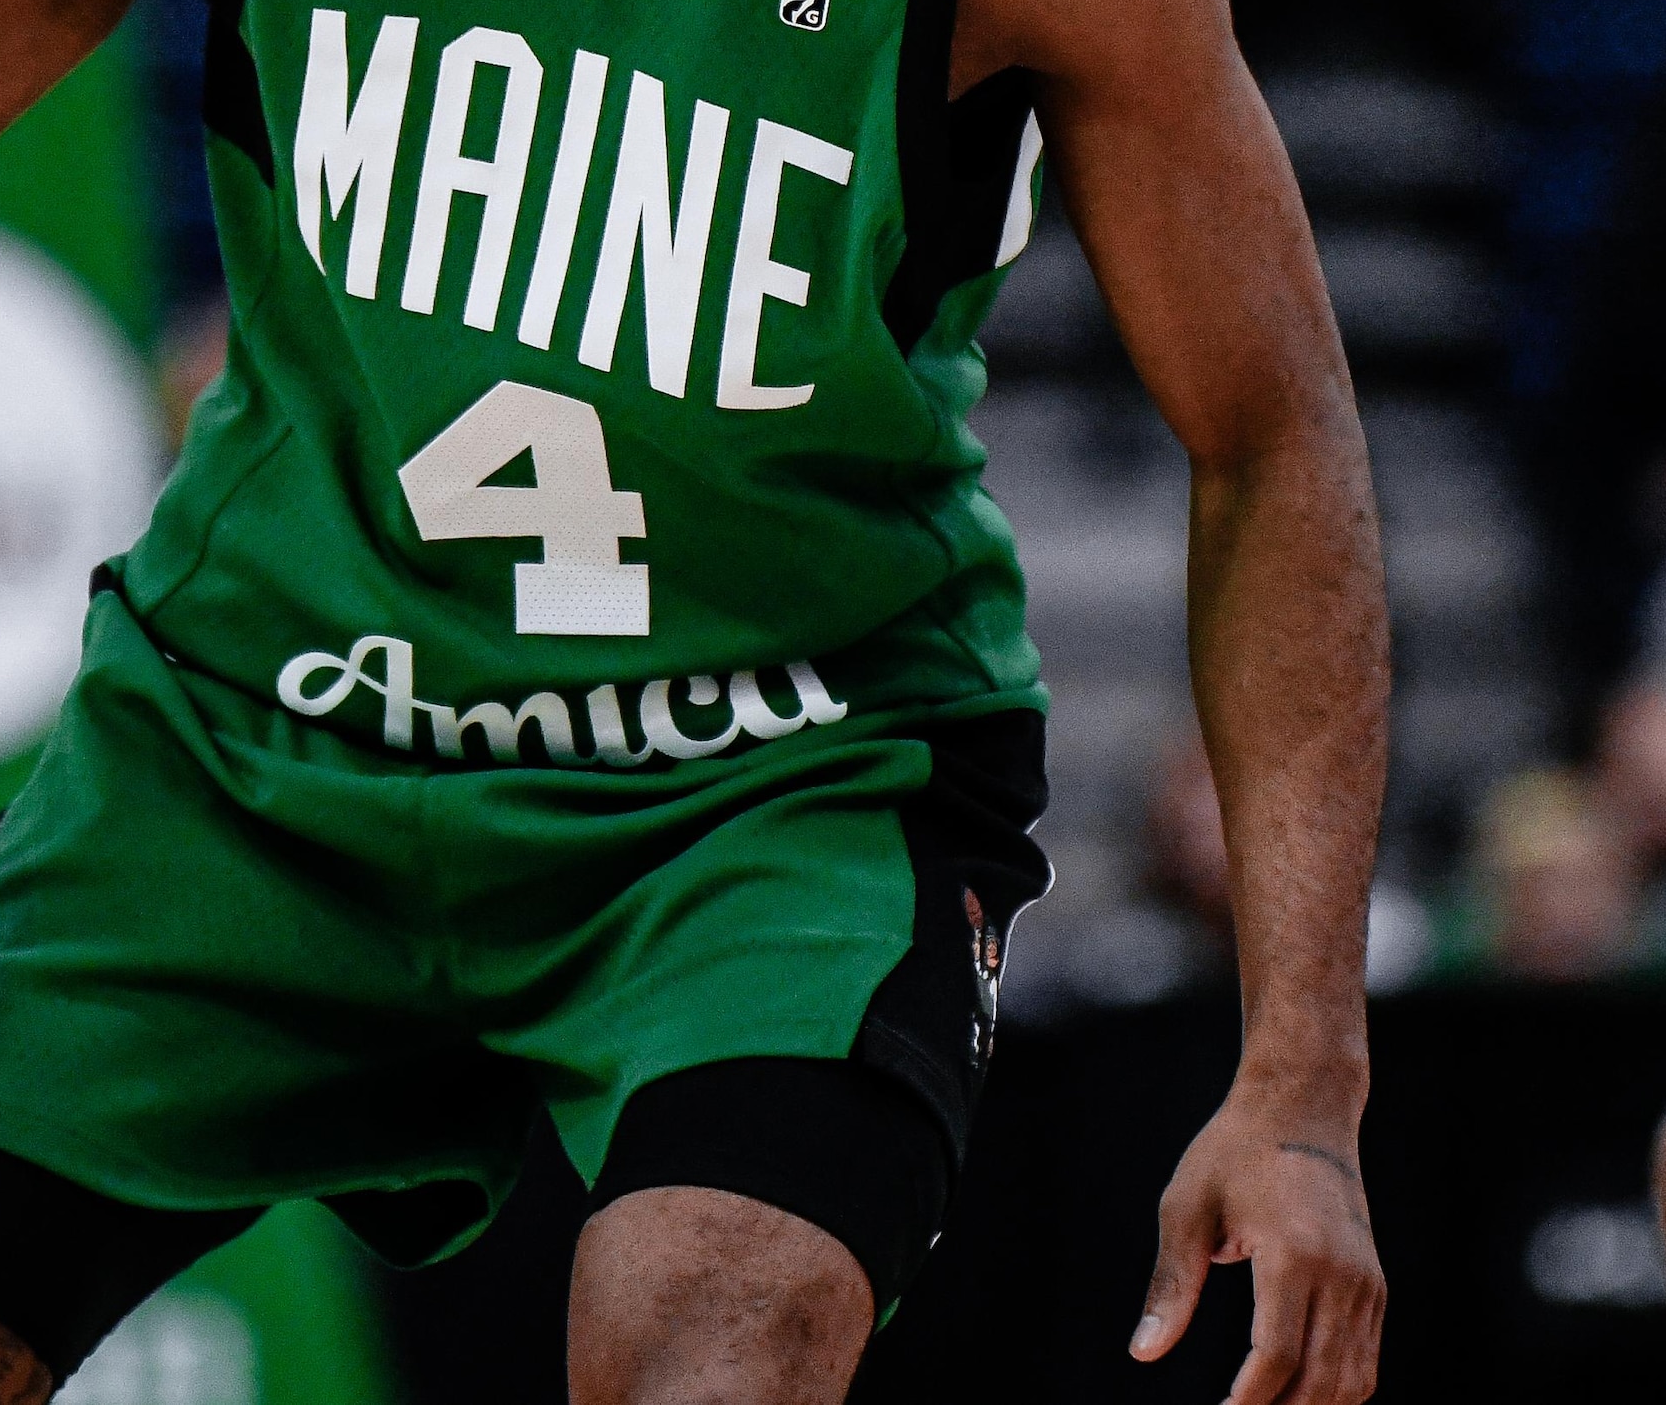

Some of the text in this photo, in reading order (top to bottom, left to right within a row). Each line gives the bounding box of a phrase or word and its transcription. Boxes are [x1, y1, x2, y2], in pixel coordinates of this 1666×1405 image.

[805, 9, 820, 25] G
[293, 7, 854, 412] MAINE
[398, 379, 651, 636] 4
[276, 635, 848, 768] Amica
